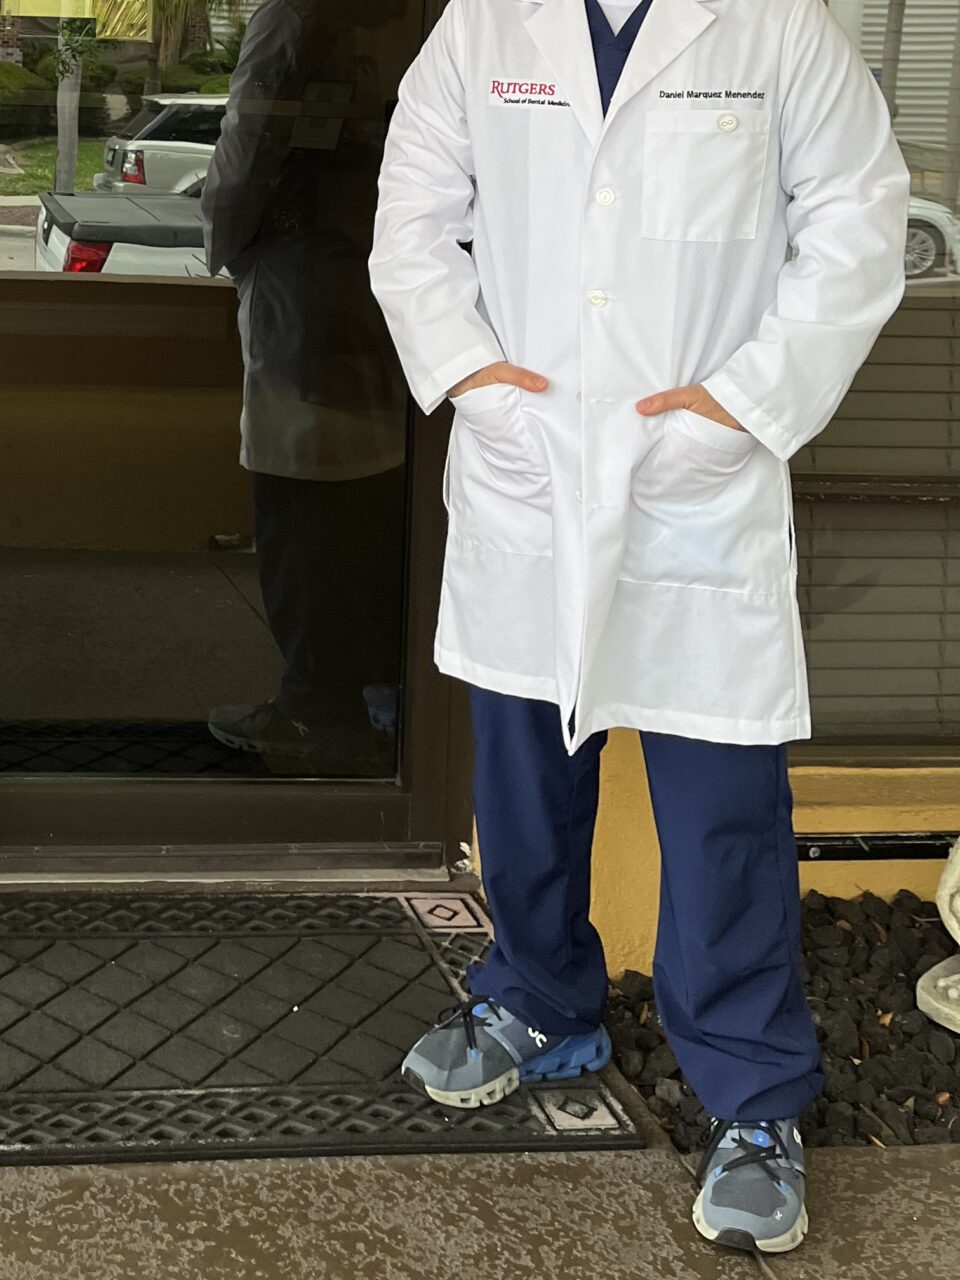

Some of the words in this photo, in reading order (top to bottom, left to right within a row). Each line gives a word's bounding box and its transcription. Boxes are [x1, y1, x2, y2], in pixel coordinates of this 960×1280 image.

[490, 80, 556, 98] RUTGERS
[659, 90, 685, 99] Daniel
[686, 90, 722, 100] Marquez
[724, 90, 765, 100] Menendez
